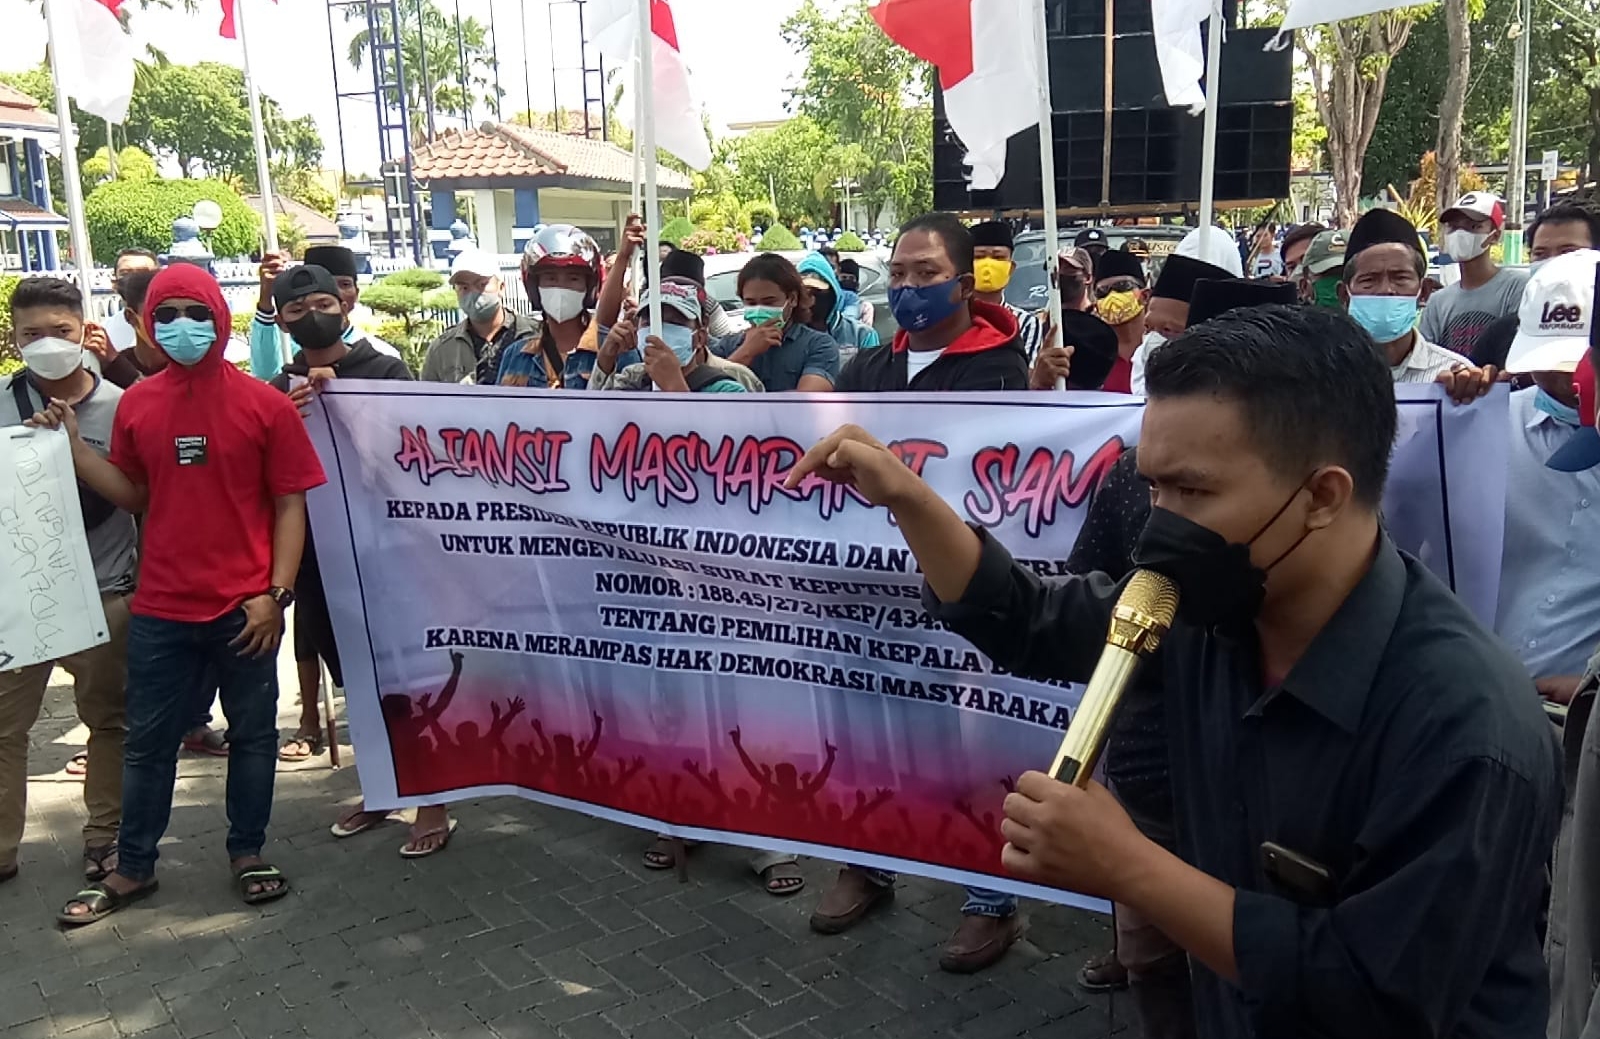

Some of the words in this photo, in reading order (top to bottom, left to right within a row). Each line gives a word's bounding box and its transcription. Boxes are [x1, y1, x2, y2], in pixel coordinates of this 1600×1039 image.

[1541, 301, 1582, 323] Lee
[395, 421, 572, 494] ALIANSI
[963, 434, 1125, 539] SAM
[386, 500, 472, 521] KEPADA
[476, 502, 578, 529] PRESIDEN
[577, 518, 690, 551] REPUBLIK
[693, 529, 839, 567] INDONESIA
[844, 543, 909, 572] DAN
[441, 533, 515, 556] UNTUK
[518, 536, 699, 574] MENGEVALUASI
[699, 562, 783, 591] SURAT
[788, 575, 922, 600] KEPUTUS
[595, 572, 684, 598] NOMOR
[599, 605, 717, 636] TENTANG
[720, 615, 862, 656] PEMILIHAN
[866, 639, 984, 675] KEPALA
[425, 628, 520, 650] KARENA
[524, 633, 652, 666] MERAMPAS
[656, 648, 713, 673] HAK
[718, 650, 876, 693] DEMOKRASI
[880, 674, 1073, 733] MASYARAKA
